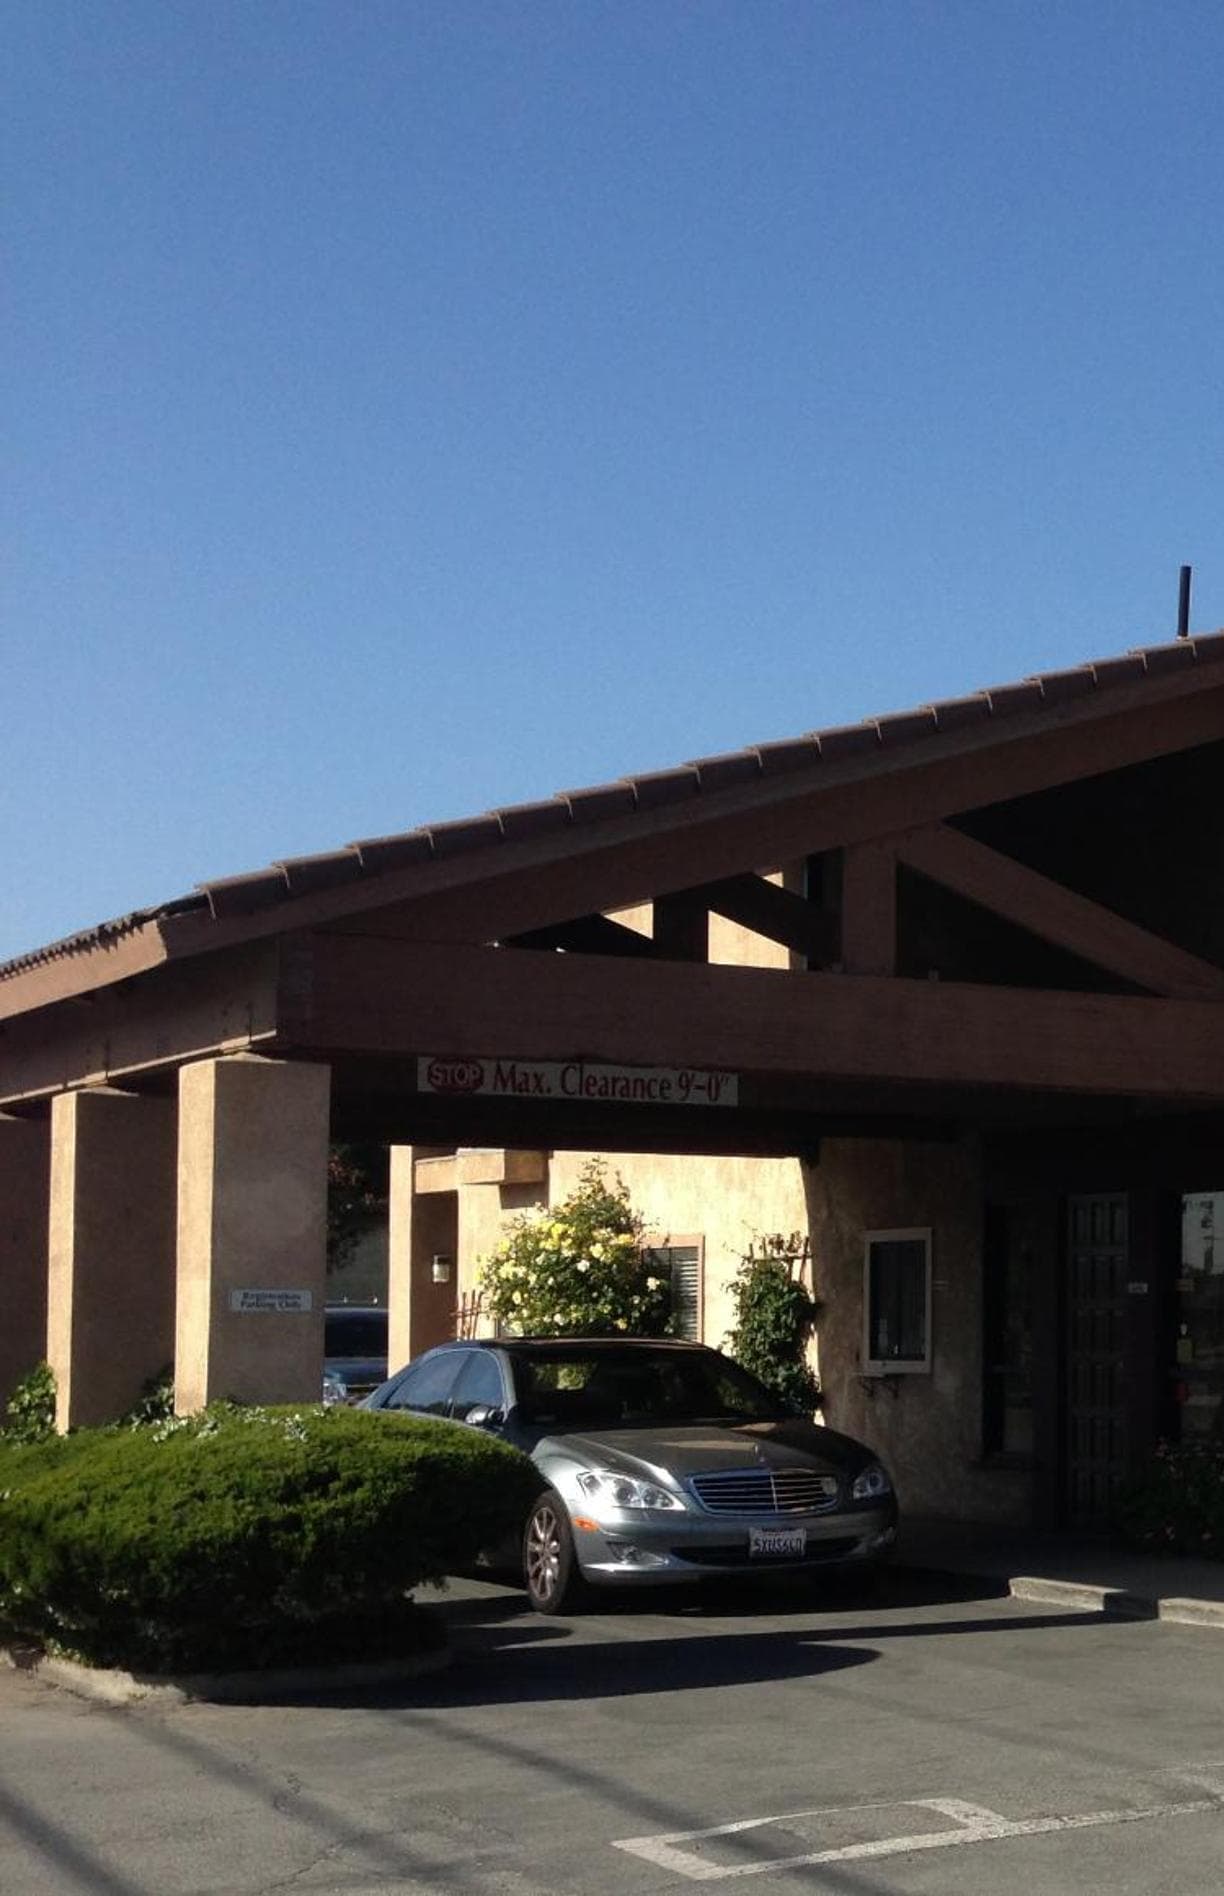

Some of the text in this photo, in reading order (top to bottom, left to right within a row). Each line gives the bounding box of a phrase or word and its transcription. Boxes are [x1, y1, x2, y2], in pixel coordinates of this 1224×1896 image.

[428, 1066, 482, 1085] STOP
[493, 1064, 550, 1094] Max.
[560, 1064, 671, 1099] Clearance
